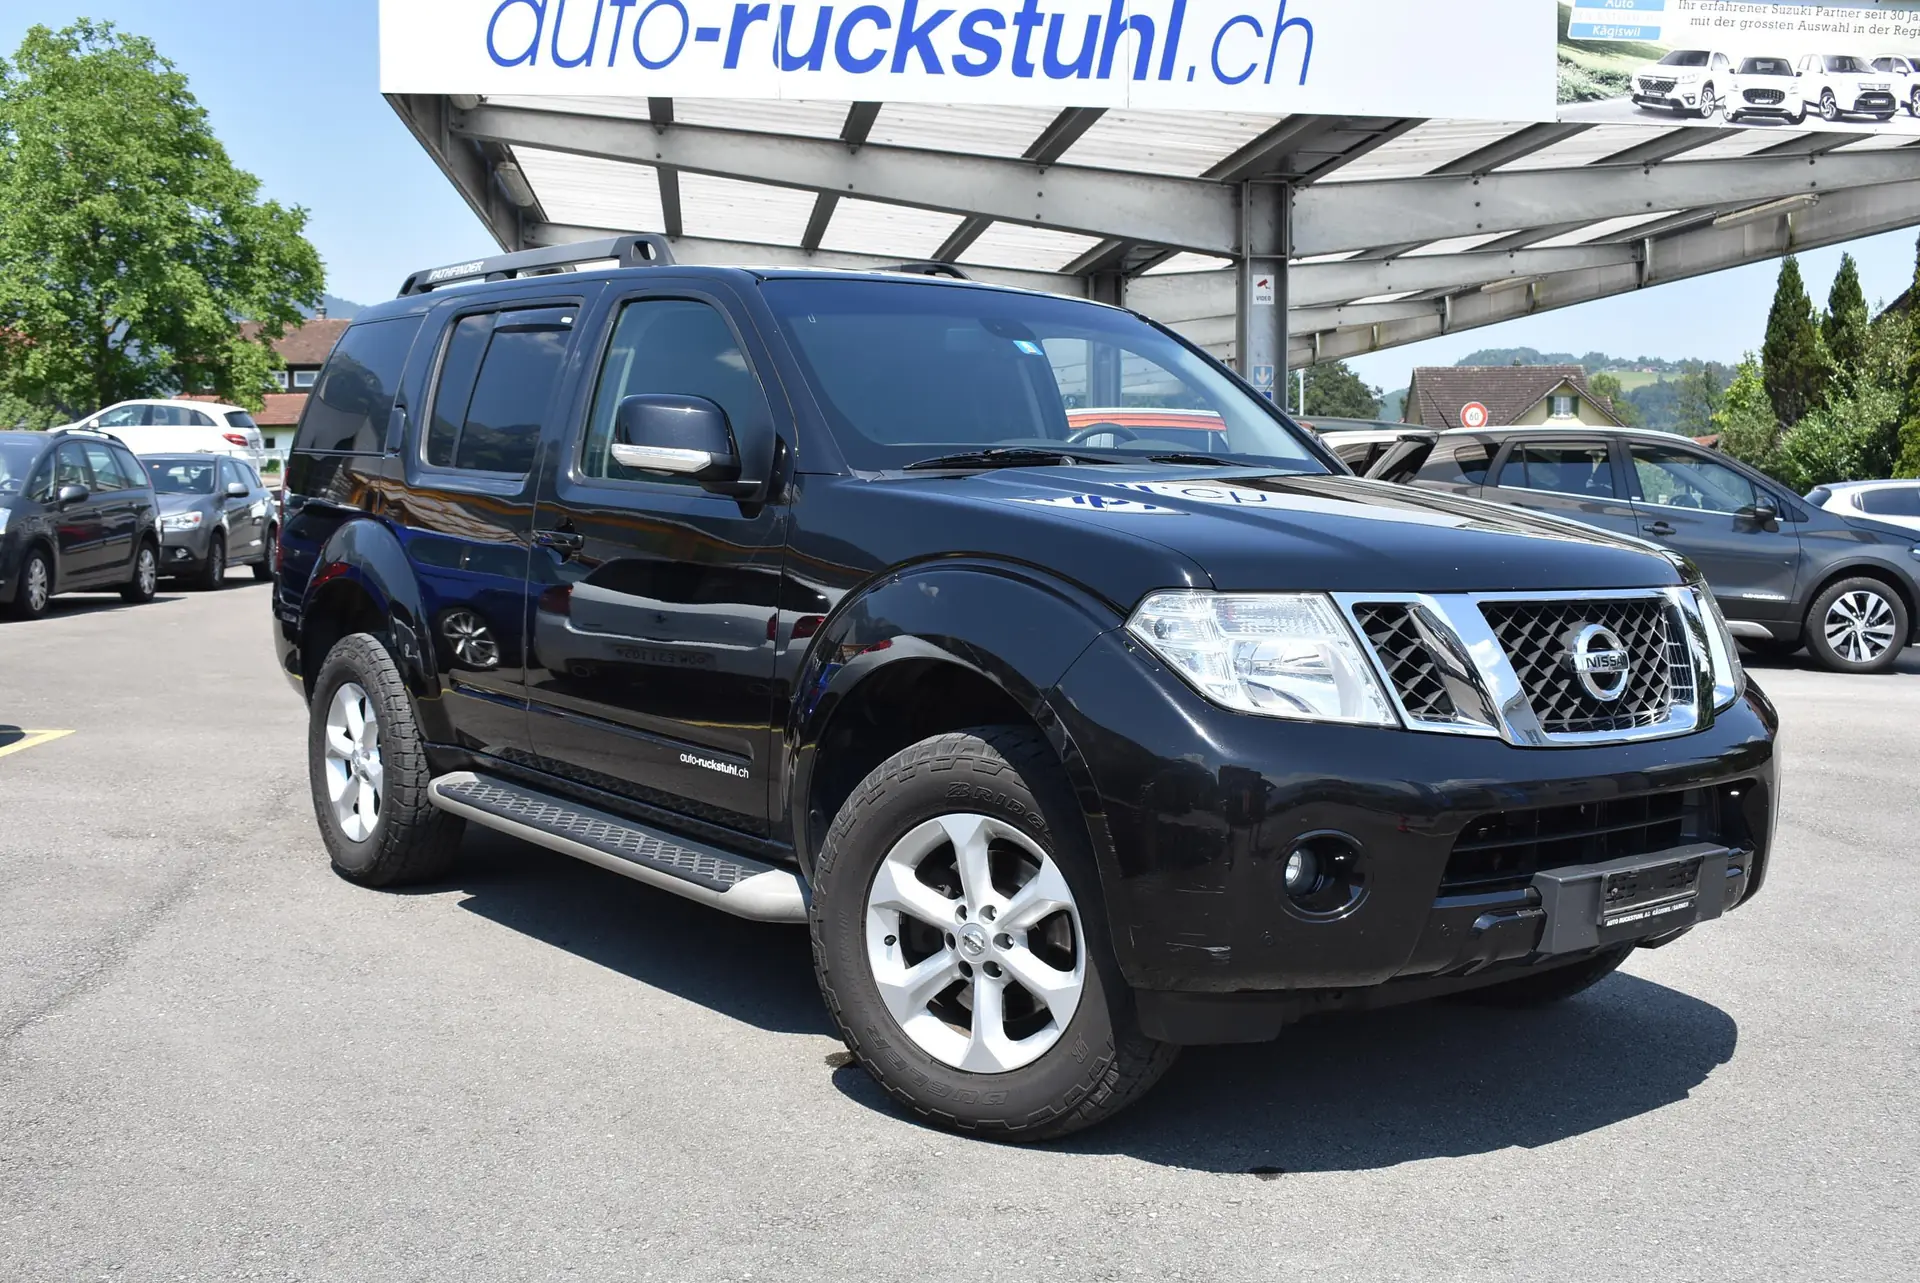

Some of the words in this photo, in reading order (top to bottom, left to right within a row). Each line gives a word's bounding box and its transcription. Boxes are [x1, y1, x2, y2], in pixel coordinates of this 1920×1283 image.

[1678, 0, 1696, 10] Ihr
[1700, 0, 1768, 14] erfahrener
[1771, 3, 1812, 16] Suzuki
[1815, 6, 1861, 19] Partner
[1864, 9, 1887, 19] seit
[1890, 9, 1905, 21] 30
[1906, 10, 1920, 24] Ja
[1690, 16, 1710, 26] mit
[1714, 16, 1736, 27] der
[1740, 19, 1794, 31] grossten
[1797, 20, 1850, 33] Auswahl
[1853, 24, 1865, 34] in
[1868, 23, 1890, 35] der
[429, 261, 484, 281] PATHFINDER
[1469, 412, 1479, 420] 60
[680, 753, 749, 779] auto-ruckstuhl.ch
